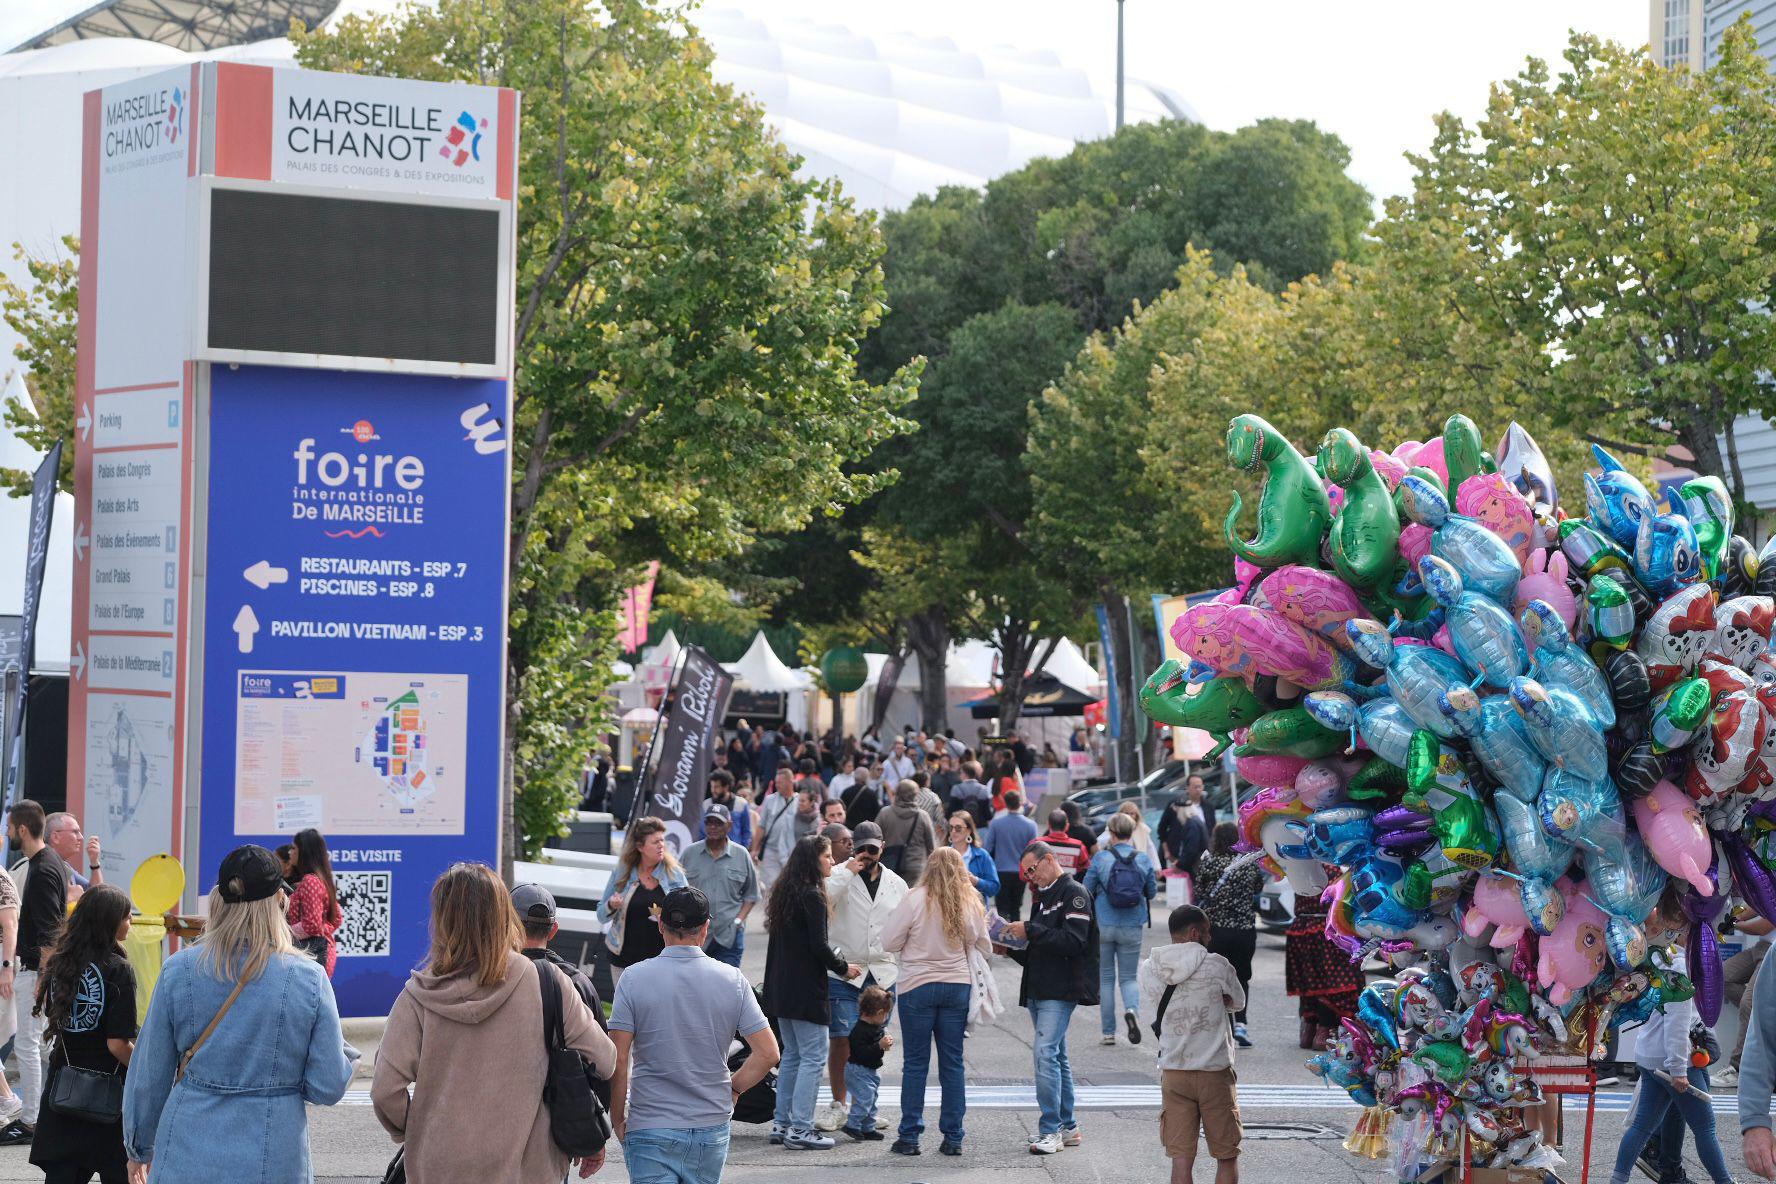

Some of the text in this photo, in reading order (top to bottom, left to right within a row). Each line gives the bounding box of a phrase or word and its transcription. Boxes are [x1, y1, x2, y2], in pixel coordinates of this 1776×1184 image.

[107, 90, 168, 127] MARSEILLE
[289, 96, 443, 132] MARSEILLE
[106, 121, 162, 158] CHANOT
[287, 126, 432, 163] CHANOT
[287, 160, 317, 173] PALAIS
[320, 162, 338, 174] DES
[404, 169, 422, 180] DES
[425, 171, 486, 186] EXPOSITIONS
[100, 413, 122, 430] Parking
[98, 460, 152, 480] Palais des Congrès
[293, 438, 425, 490] foire
[292, 486, 424, 504] internationale
[97, 498, 140, 513] Palais des Arts
[292, 502, 318, 520] De
[96, 530, 161, 549] Palais des Événements
[96, 568, 131, 584] Grand Palais
[301, 557, 412, 577] RESTAURANTS
[300, 578, 378, 597] PISCINES
[95, 604, 145, 622] Palais de l'Europe
[271, 621, 350, 640] PAVILLON
[352, 622, 427, 641] VIETNAM
[94, 655, 161, 672] Palais de la Méditerranée
[654, 725, 700, 818] Giovanni
[341, 850, 358, 863] DE
[360, 850, 402, 863] VISITE
